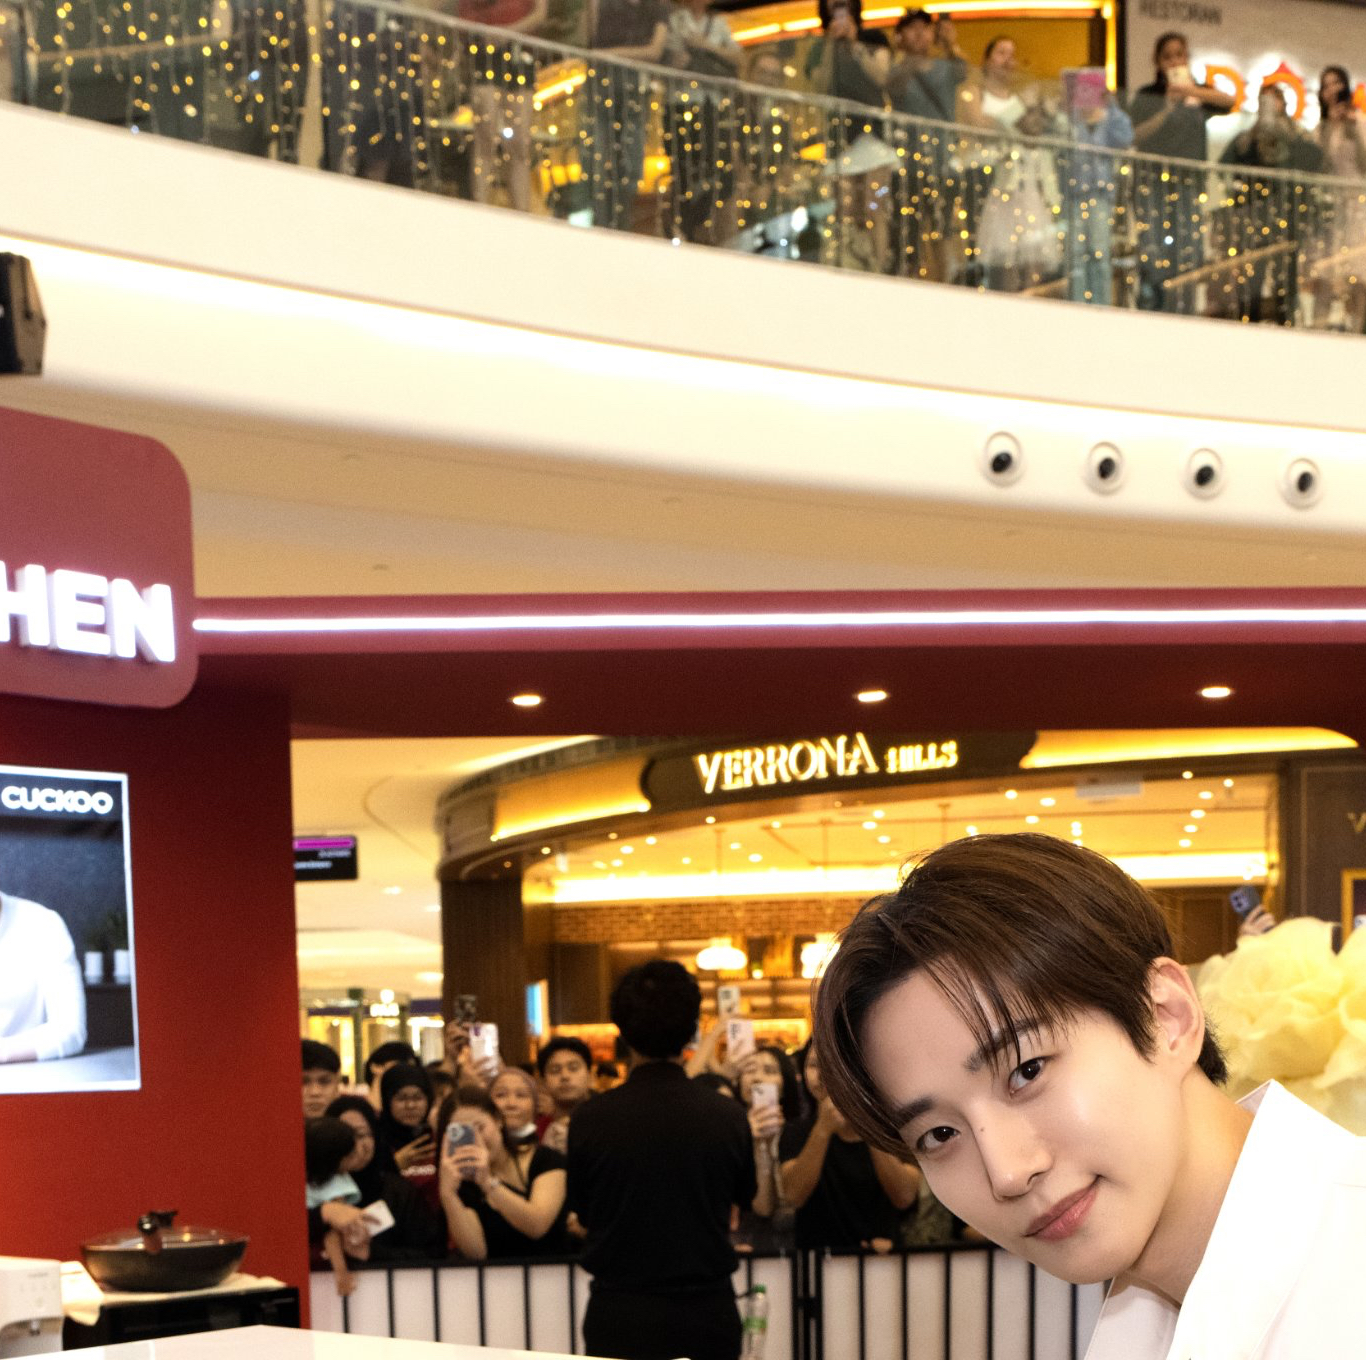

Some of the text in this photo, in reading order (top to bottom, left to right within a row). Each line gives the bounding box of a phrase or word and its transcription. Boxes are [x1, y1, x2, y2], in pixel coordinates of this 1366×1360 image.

[695, 731, 959, 794] VERRONA HILLS
[0, 785, 114, 815] CUCKOO
